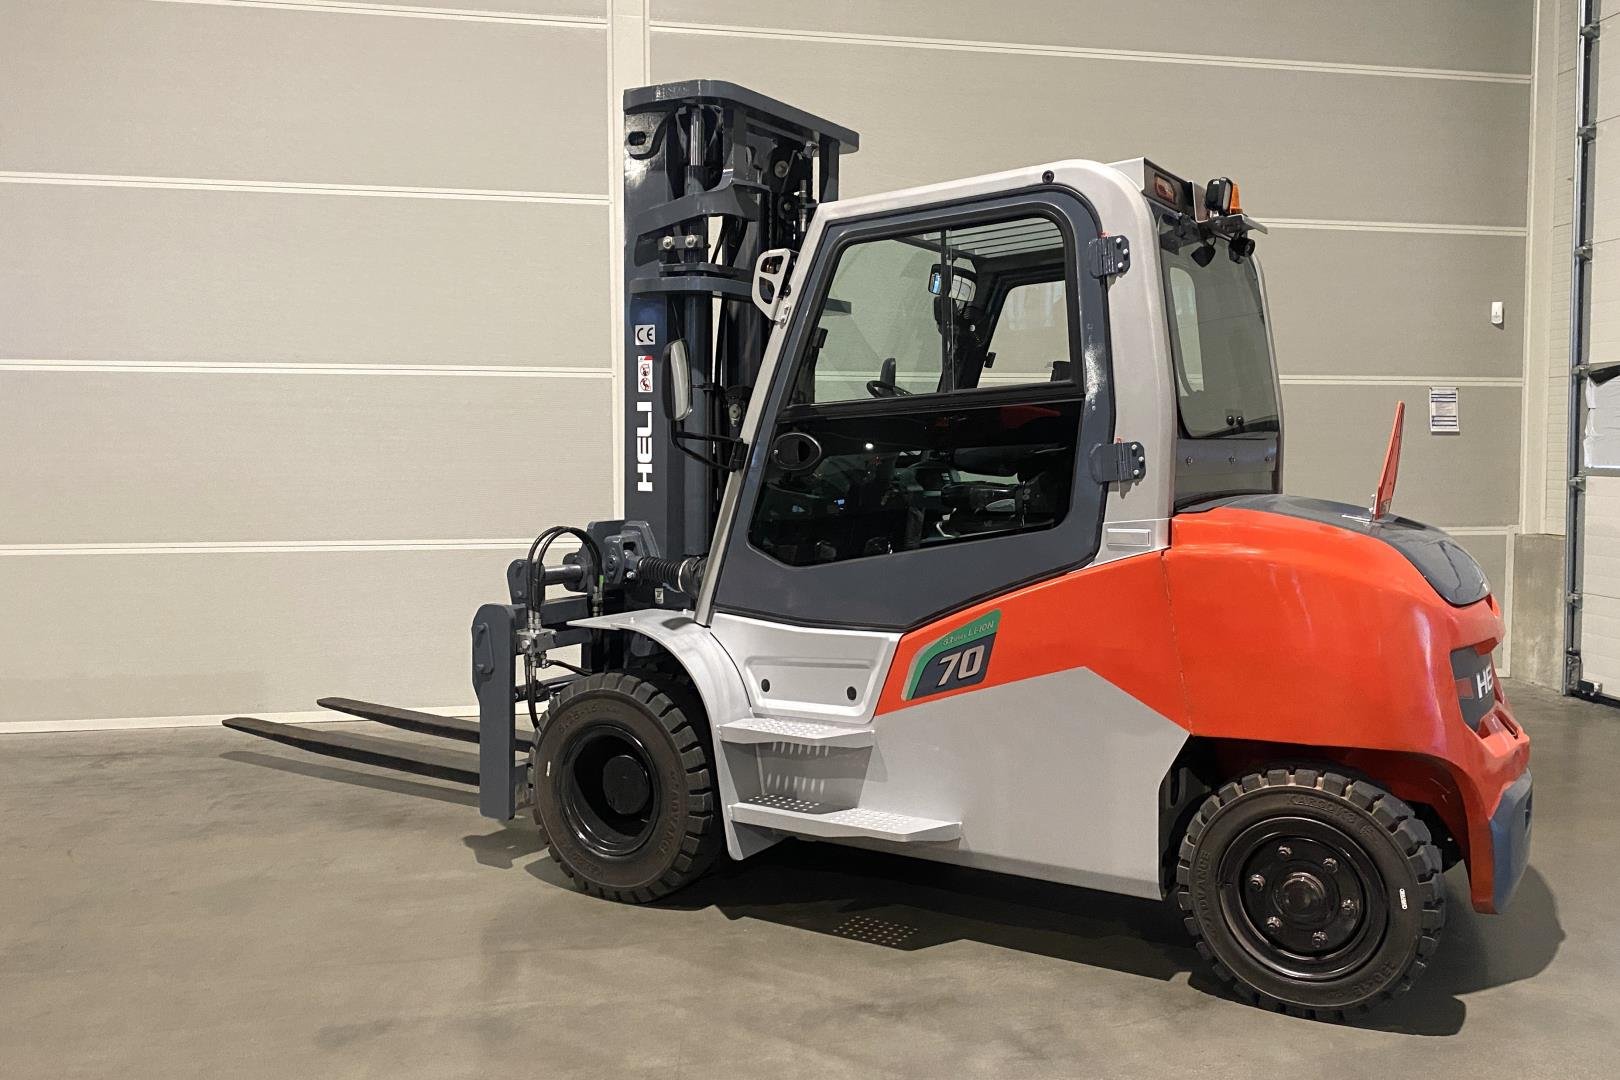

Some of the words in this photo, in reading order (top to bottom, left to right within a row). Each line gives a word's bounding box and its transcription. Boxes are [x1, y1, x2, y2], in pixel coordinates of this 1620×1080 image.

[637, 327, 654, 342] CE
[636, 401, 653, 492] HELI
[938, 645, 985, 686] 70
